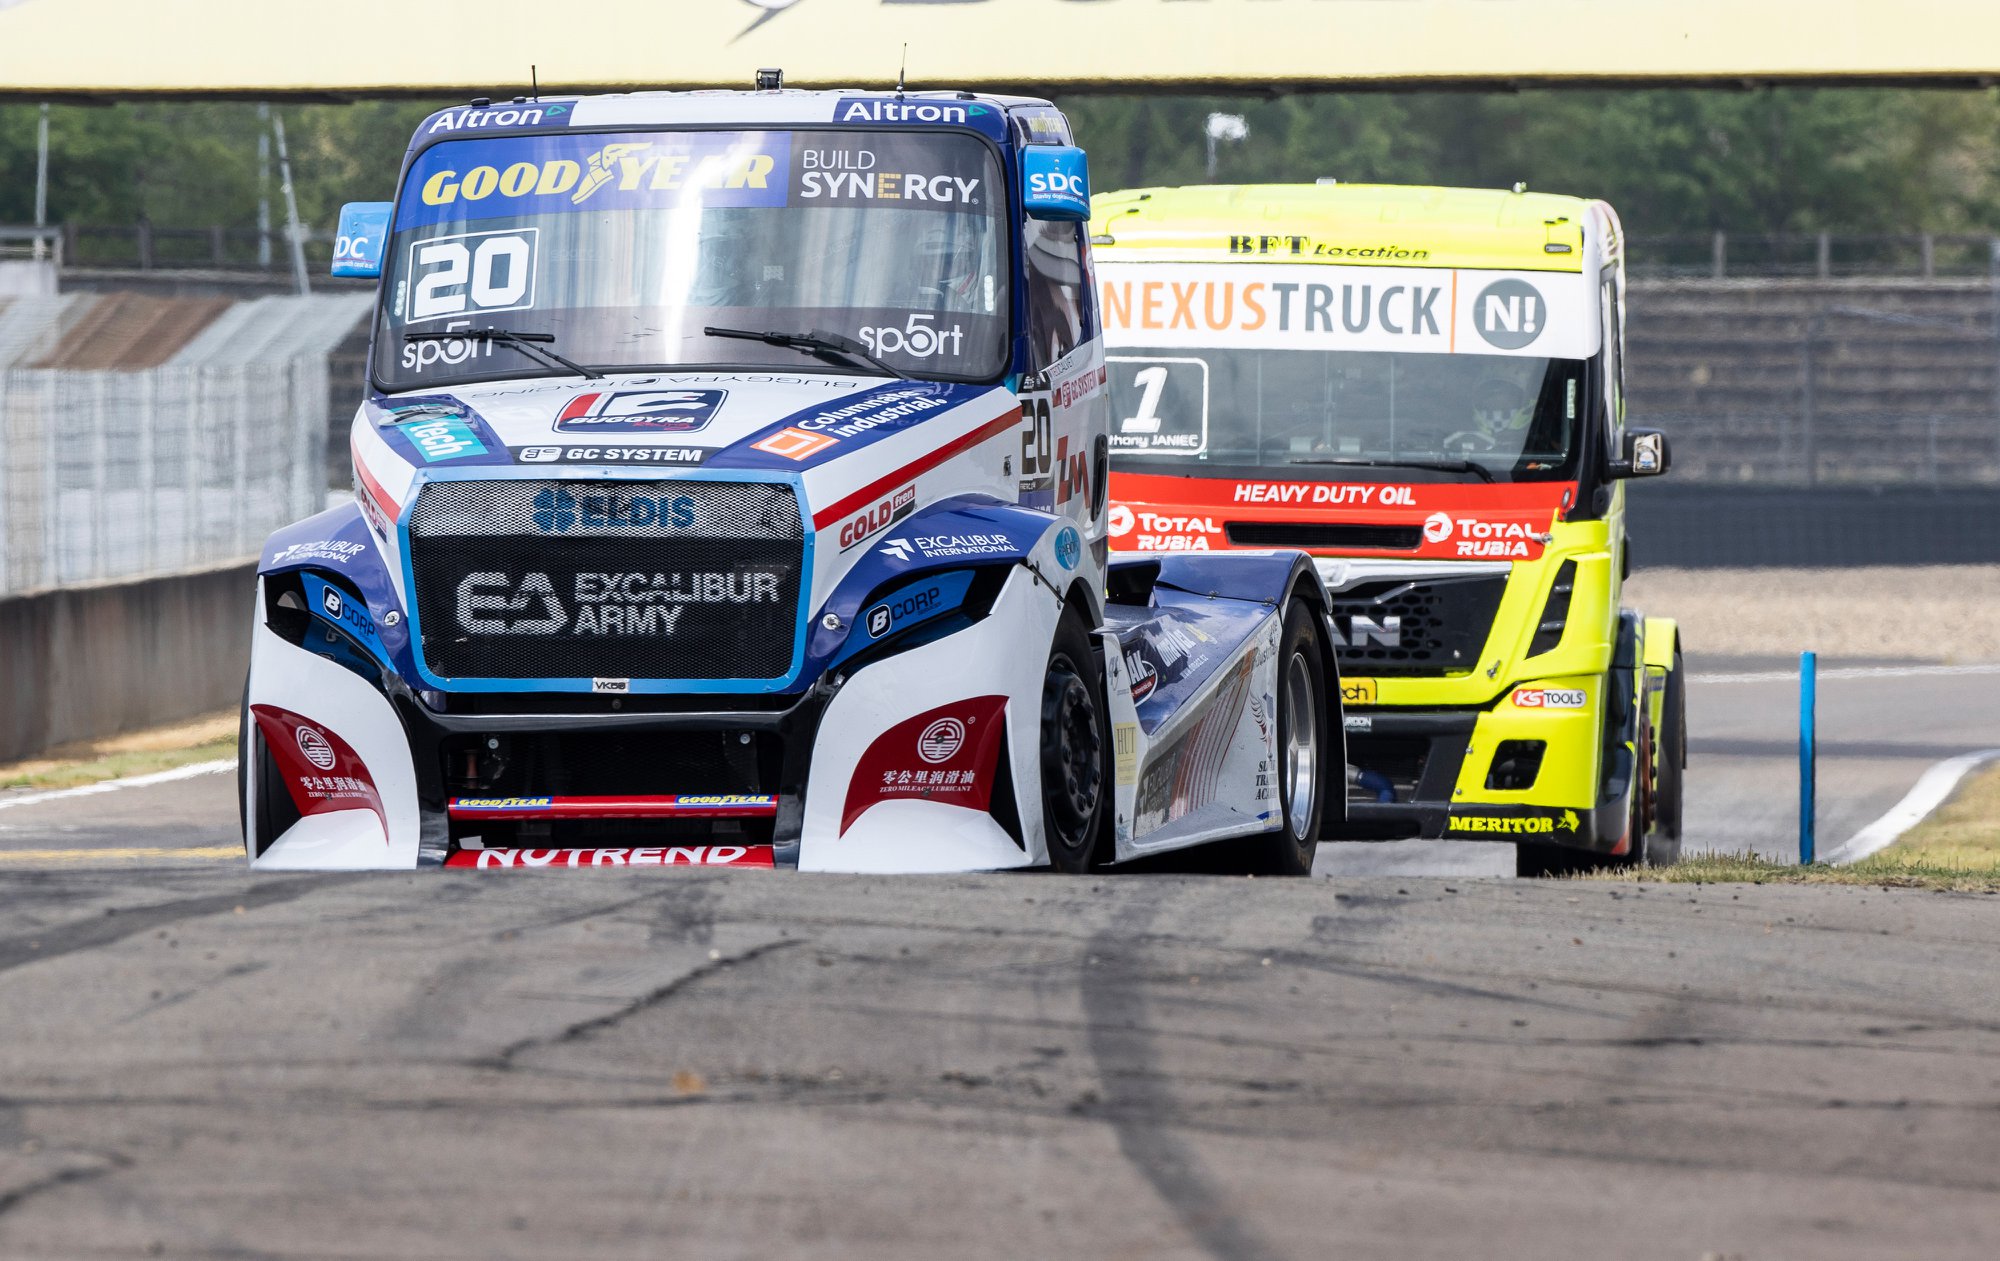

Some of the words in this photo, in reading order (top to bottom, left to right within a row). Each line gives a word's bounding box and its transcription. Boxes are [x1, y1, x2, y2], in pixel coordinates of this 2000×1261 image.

[429, 109, 543, 134] Altron
[843, 101, 966, 123] Altron
[803, 149, 876, 170] BUILD
[800, 171, 980, 204] SYNERGY
[1030, 172, 1084, 197] SDC
[1229, 236, 1309, 255] BFT
[1313, 243, 1429, 260] Location
[413, 236, 530, 318] 20
[1484, 294, 1537, 334] N!
[1120, 366, 1168, 433] 1
[566, 416, 695, 424] BUGGYRA
[408, 421, 474, 457] tech
[1019, 397, 1052, 475] 20
[1151, 434, 1198, 447] JANIEC
[566, 447, 601, 461] GC
[603, 447, 703, 462] SYSTEM
[1234, 484, 1310, 504] HEAVY
[1312, 485, 1377, 505] DUTY
[1379, 486, 1417, 506] OIL
[581, 495, 696, 529] ELDIS
[1137, 512, 1222, 534] TOTAL
[1456, 518, 1538, 539] TOTAL
[298, 540, 366, 557] EXCALIBUR
[913, 534, 1012, 551] EXCALIBUR
[922, 544, 1020, 559] INTERNATIONAL
[574, 571, 780, 604] EXCALIBUR
[573, 604, 684, 636] ARMY
[1326, 614, 1401, 647] AN
[1515, 690, 1544, 707] KS
[1543, 691, 1585, 705] TOOLS
[1116, 727, 1137, 755] HUT
[882, 769, 976, 785] 零公里润滑油
[879, 785, 898, 793] ZERO
[1449, 816, 1554, 834] MERITOR
[476, 846, 748, 869] NUTREND
